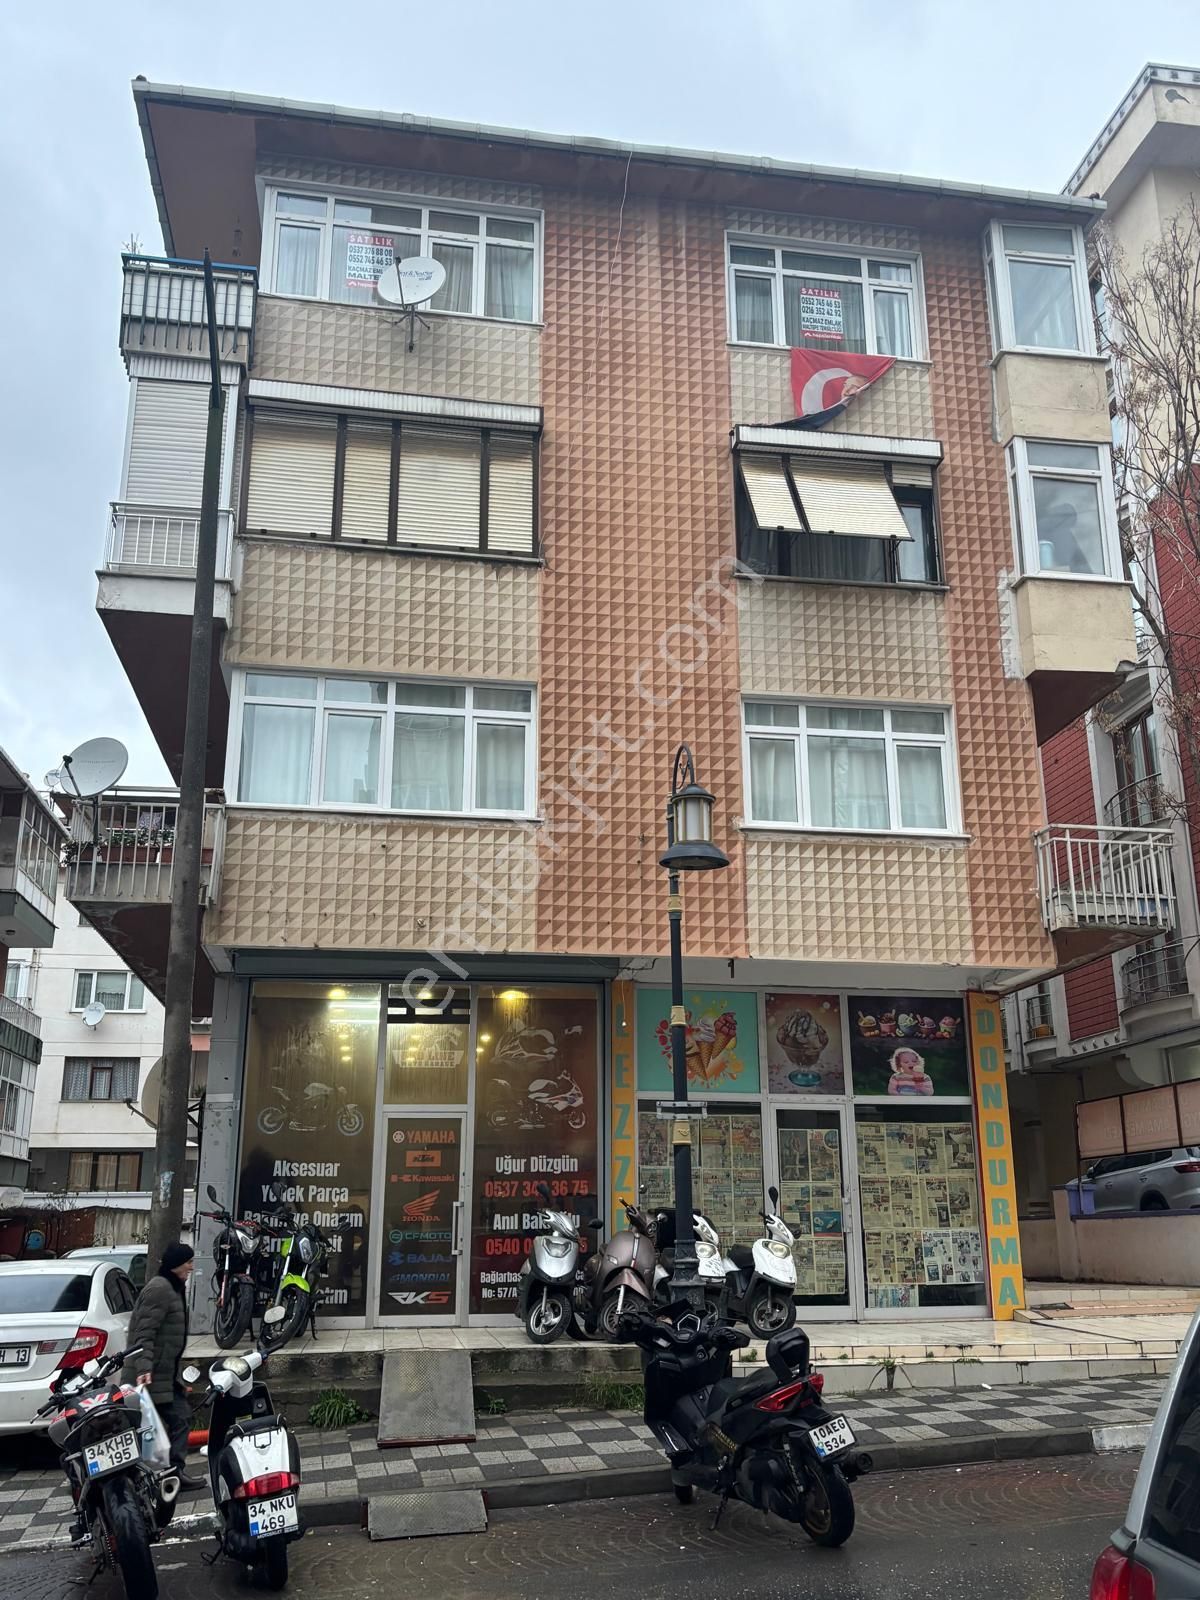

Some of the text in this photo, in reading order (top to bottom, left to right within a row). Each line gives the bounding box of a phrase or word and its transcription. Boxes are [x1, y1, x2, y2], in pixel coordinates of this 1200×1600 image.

[349, 234, 393, 246] SATILIK
[348, 245, 363, 254] 0537
[348, 254, 363, 263] 0552
[364, 255, 375, 265] 745
[801, 287, 839, 299] SATILIK
[801, 296, 815, 305] 0552
[407, 1130, 456, 1144] YAMAHA
[976, 1008, 1019, 1306] DONDURMA
[272, 1160, 341, 1177] Aksesuar
[495, 1154, 579, 1175] Uğur Düzgün
[412, 1174, 456, 1182] Kawasaki
[308, 1184, 349, 1208] Parça
[484, 1180, 519, 1198] 0537
[551, 1180, 568, 1197] 36
[571, 1180, 589, 1196] 75
[402, 1214, 441, 1222] HONDA
[493, 1213, 519, 1230] Anıl
[405, 1231, 452, 1241] CFMOTO
[485, 1238, 520, 1255] 0540
[407, 1253, 454, 1264] BAJAJ
[482, 1286, 518, 1299] No: 57/A
[15, 1349, 28, 1362] 13
[824, 1433, 846, 1452] 534
[108, 1447, 132, 1466] 195
[249, 1495, 295, 1518] 34 NKU
[261, 1514, 286, 1531] 469
